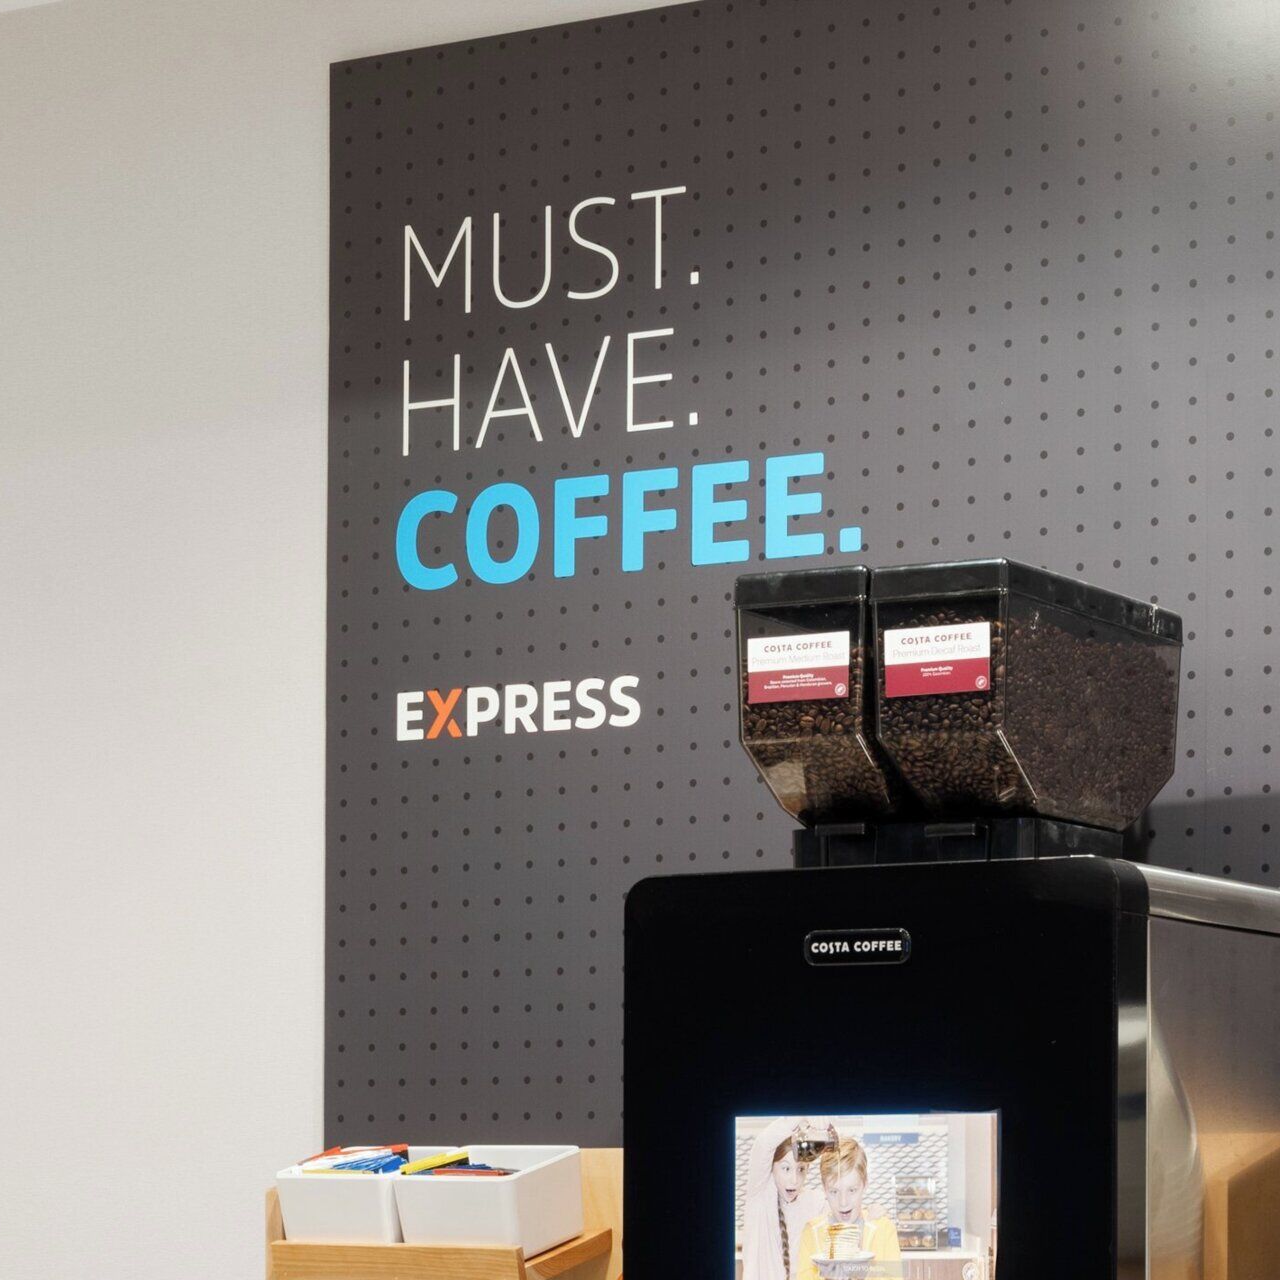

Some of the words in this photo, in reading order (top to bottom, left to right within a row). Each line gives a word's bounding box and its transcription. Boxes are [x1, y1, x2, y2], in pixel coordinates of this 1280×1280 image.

[403, 185, 700, 321] MUST.
[402, 327, 699, 456] HAVE.
[395, 451, 862, 590] COFFEE.
[763, 643, 792, 653] COSTA
[796, 640, 832, 651] COFFEE
[901, 635, 931, 645] COSTA
[934, 632, 972, 643] COFFEE
[396, 675, 642, 742] EXPRESS
[810, 941, 850, 954] COSTA
[853, 940, 902, 952] COFFEE
